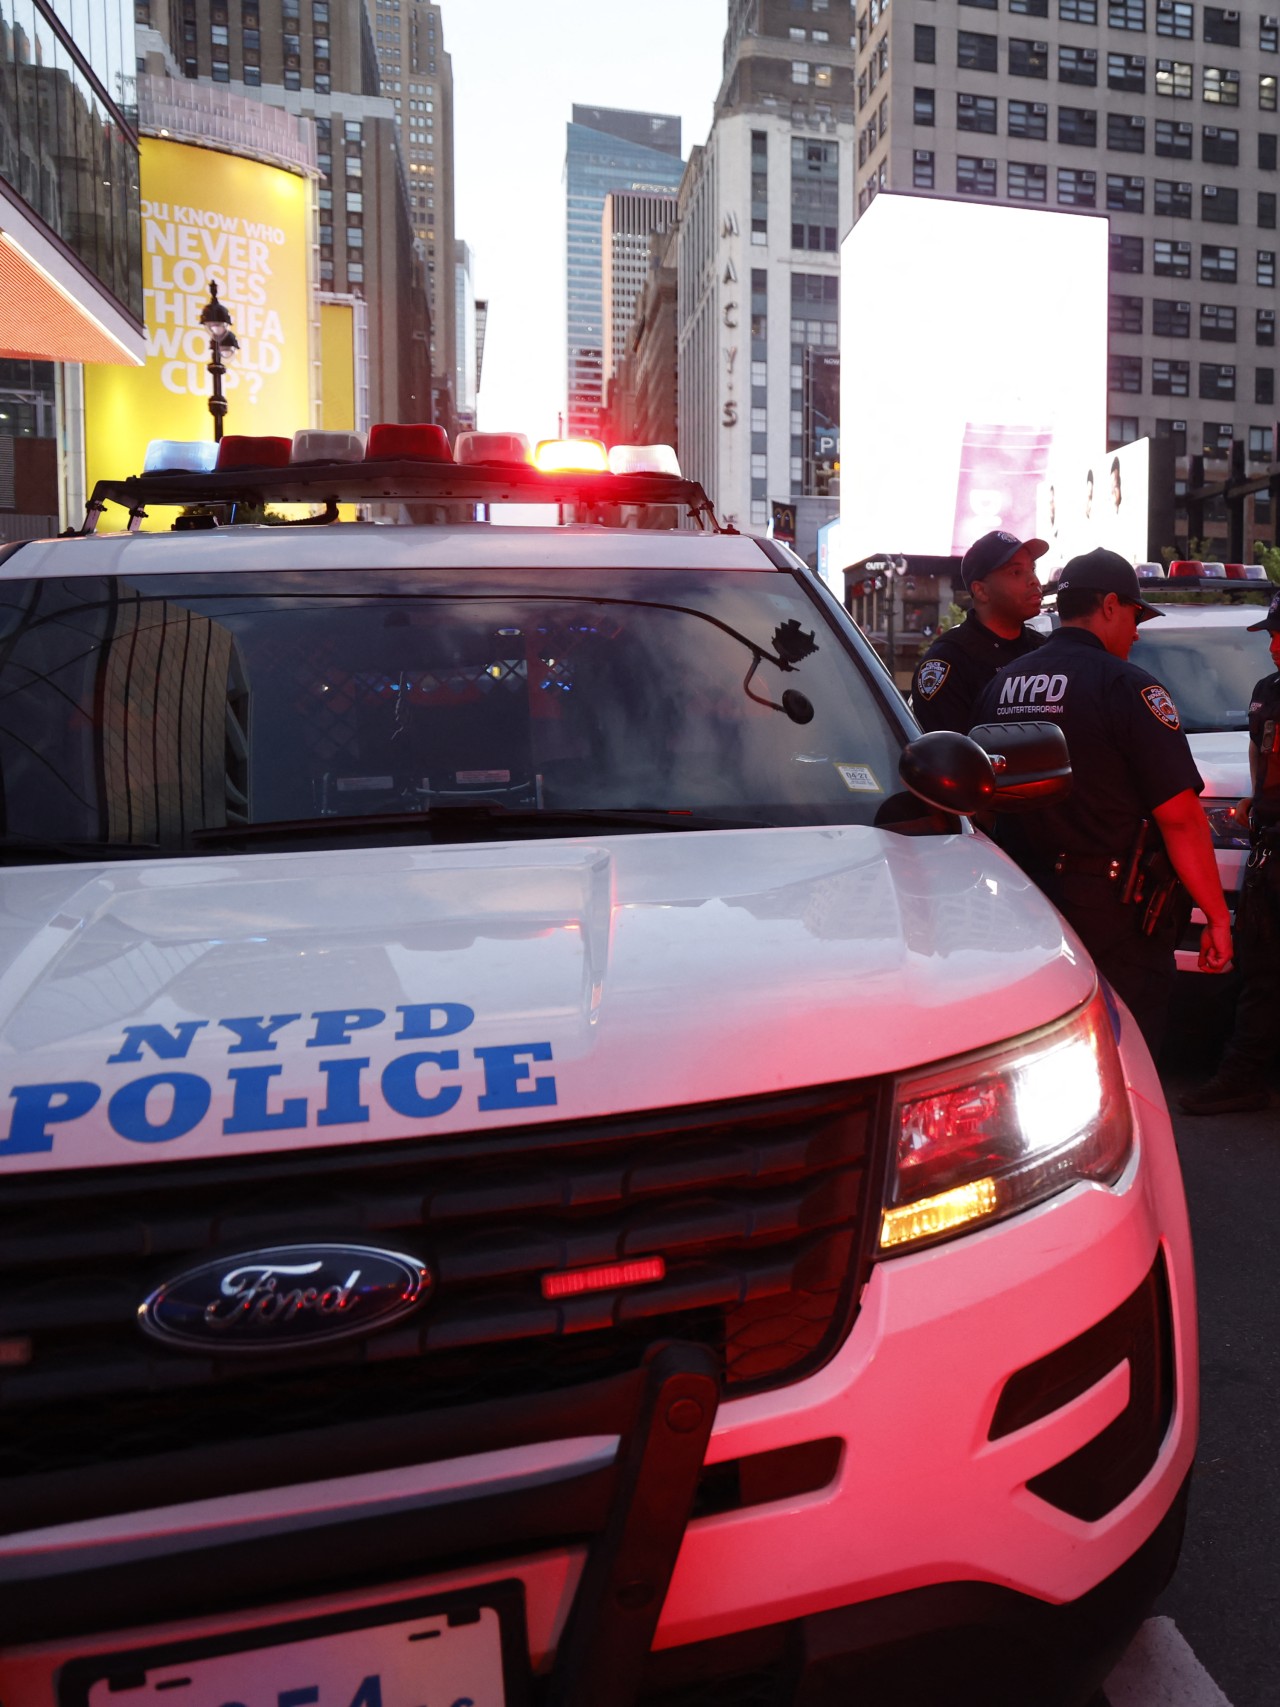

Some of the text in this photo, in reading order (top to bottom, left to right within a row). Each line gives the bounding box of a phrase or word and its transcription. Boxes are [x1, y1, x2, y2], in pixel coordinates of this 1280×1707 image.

[140, 200, 285, 245] OU KNOW WHO
[145, 219, 273, 275] NEVER
[152, 255, 267, 306] LOSES
[143, 288, 206, 329] THE
[996, 705, 1064, 716] COUNTERTERRORISM
[999, 674, 1068, 705] NYPD
[107, 1002, 475, 1065] NYPD
[0, 1041, 558, 1157] POLICE
[204, 1260, 362, 1330] Ford
